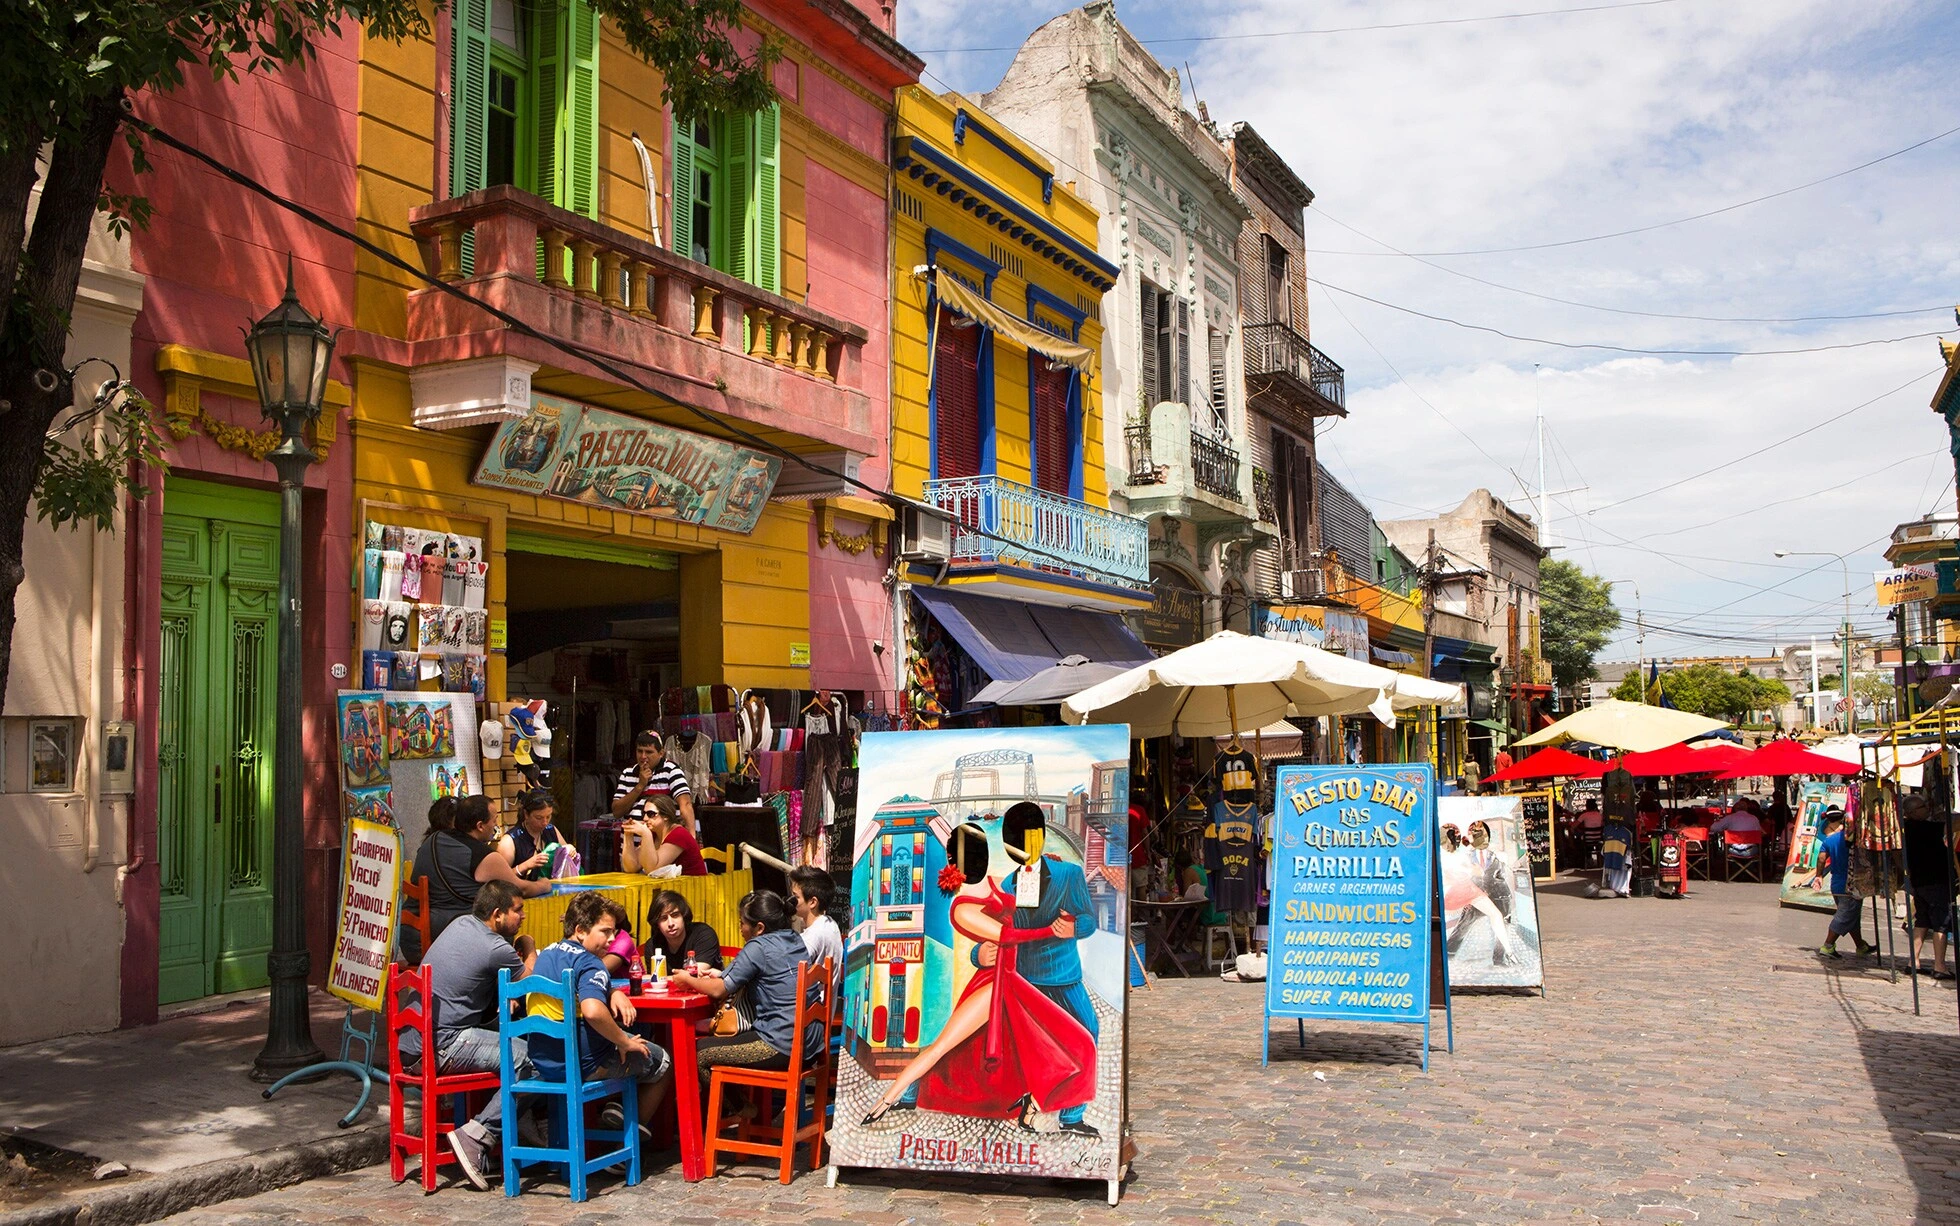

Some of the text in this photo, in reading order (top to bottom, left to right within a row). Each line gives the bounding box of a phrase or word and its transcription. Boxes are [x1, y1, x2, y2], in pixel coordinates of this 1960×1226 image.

[577, 429, 719, 496] PASEO DEL VALLE
[1910, 566, 1939, 579] ALQUILA
[1260, 613, 1324, 633] Costumbres
[1226, 760, 1246, 786] 10
[1292, 777, 1418, 816] RESTO BAR
[1340, 808, 1371, 827] LAS
[1304, 820, 1400, 851] GEMELAS
[351, 833, 393, 865] CHORIPAN
[1222, 854, 1249, 867] BOCA
[1293, 856, 1404, 878] PARRILLA
[349, 859, 379, 888] VACIO
[1293, 883, 1405, 895] CARNES ARGENTINAS
[346, 884, 392, 917] BONDIOLA
[1285, 900, 1417, 923] SANDWICHES
[878, 941, 921, 960] CAMINITO
[1284, 931, 1412, 948] HAMBURGUESAS
[1283, 950, 1380, 967] CHORIPANES
[332, 962, 380, 997] MILANESA
[1282, 988, 1414, 1009] SUPER PANCHOS
[896, 1133, 1040, 1166] PASEO DEL VALLE
